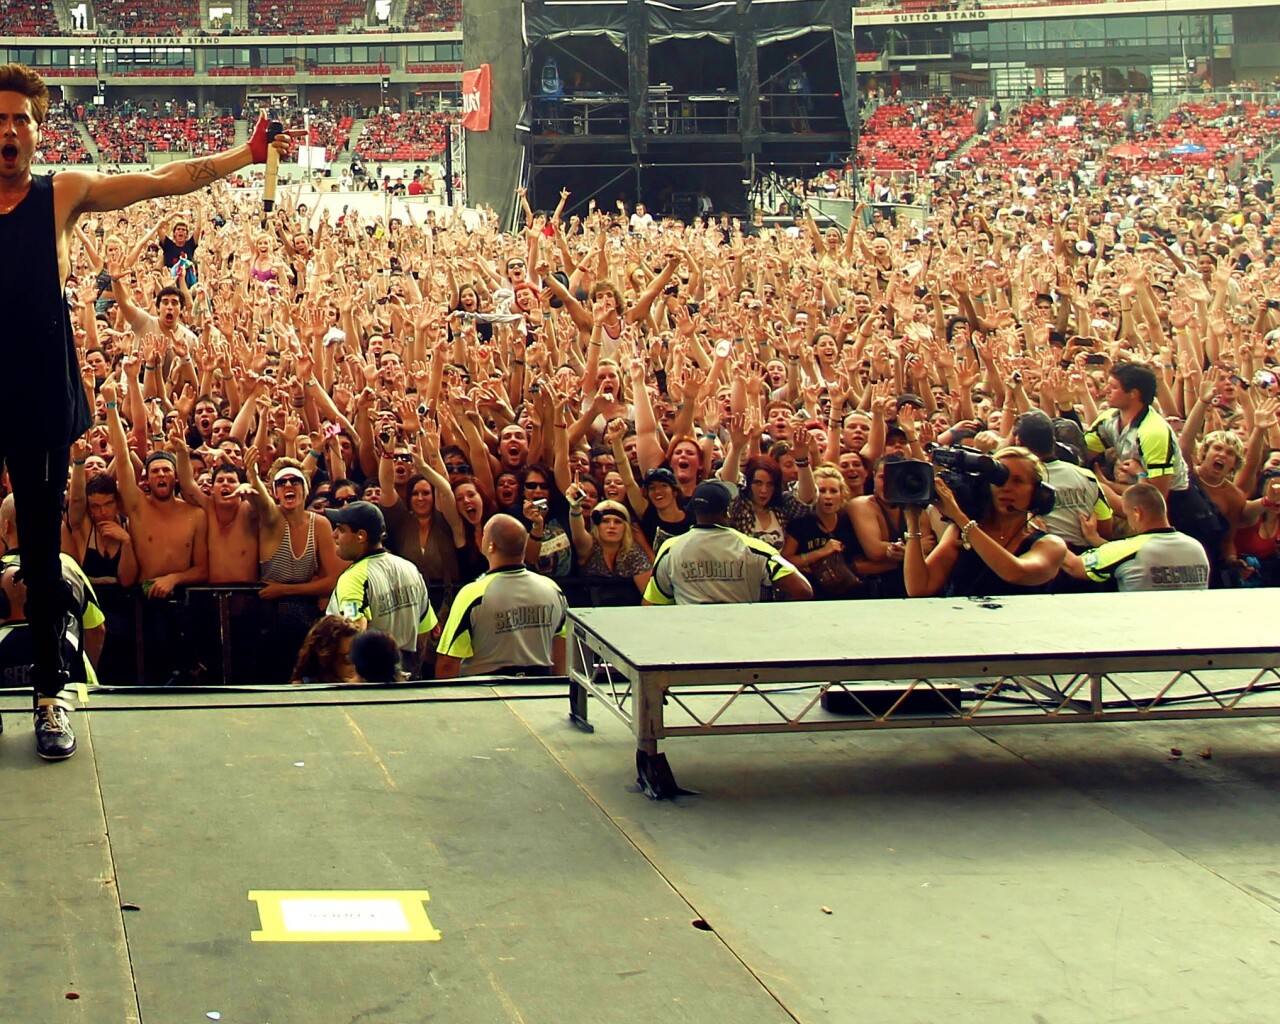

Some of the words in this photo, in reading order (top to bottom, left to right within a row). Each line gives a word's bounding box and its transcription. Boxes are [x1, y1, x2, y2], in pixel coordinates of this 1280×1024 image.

[894, 14, 938, 22] SUTTOR
[946, 11, 985, 20] STAND
[681, 561, 745, 578] SECURITY
[496, 604, 554, 629] SECURITY
